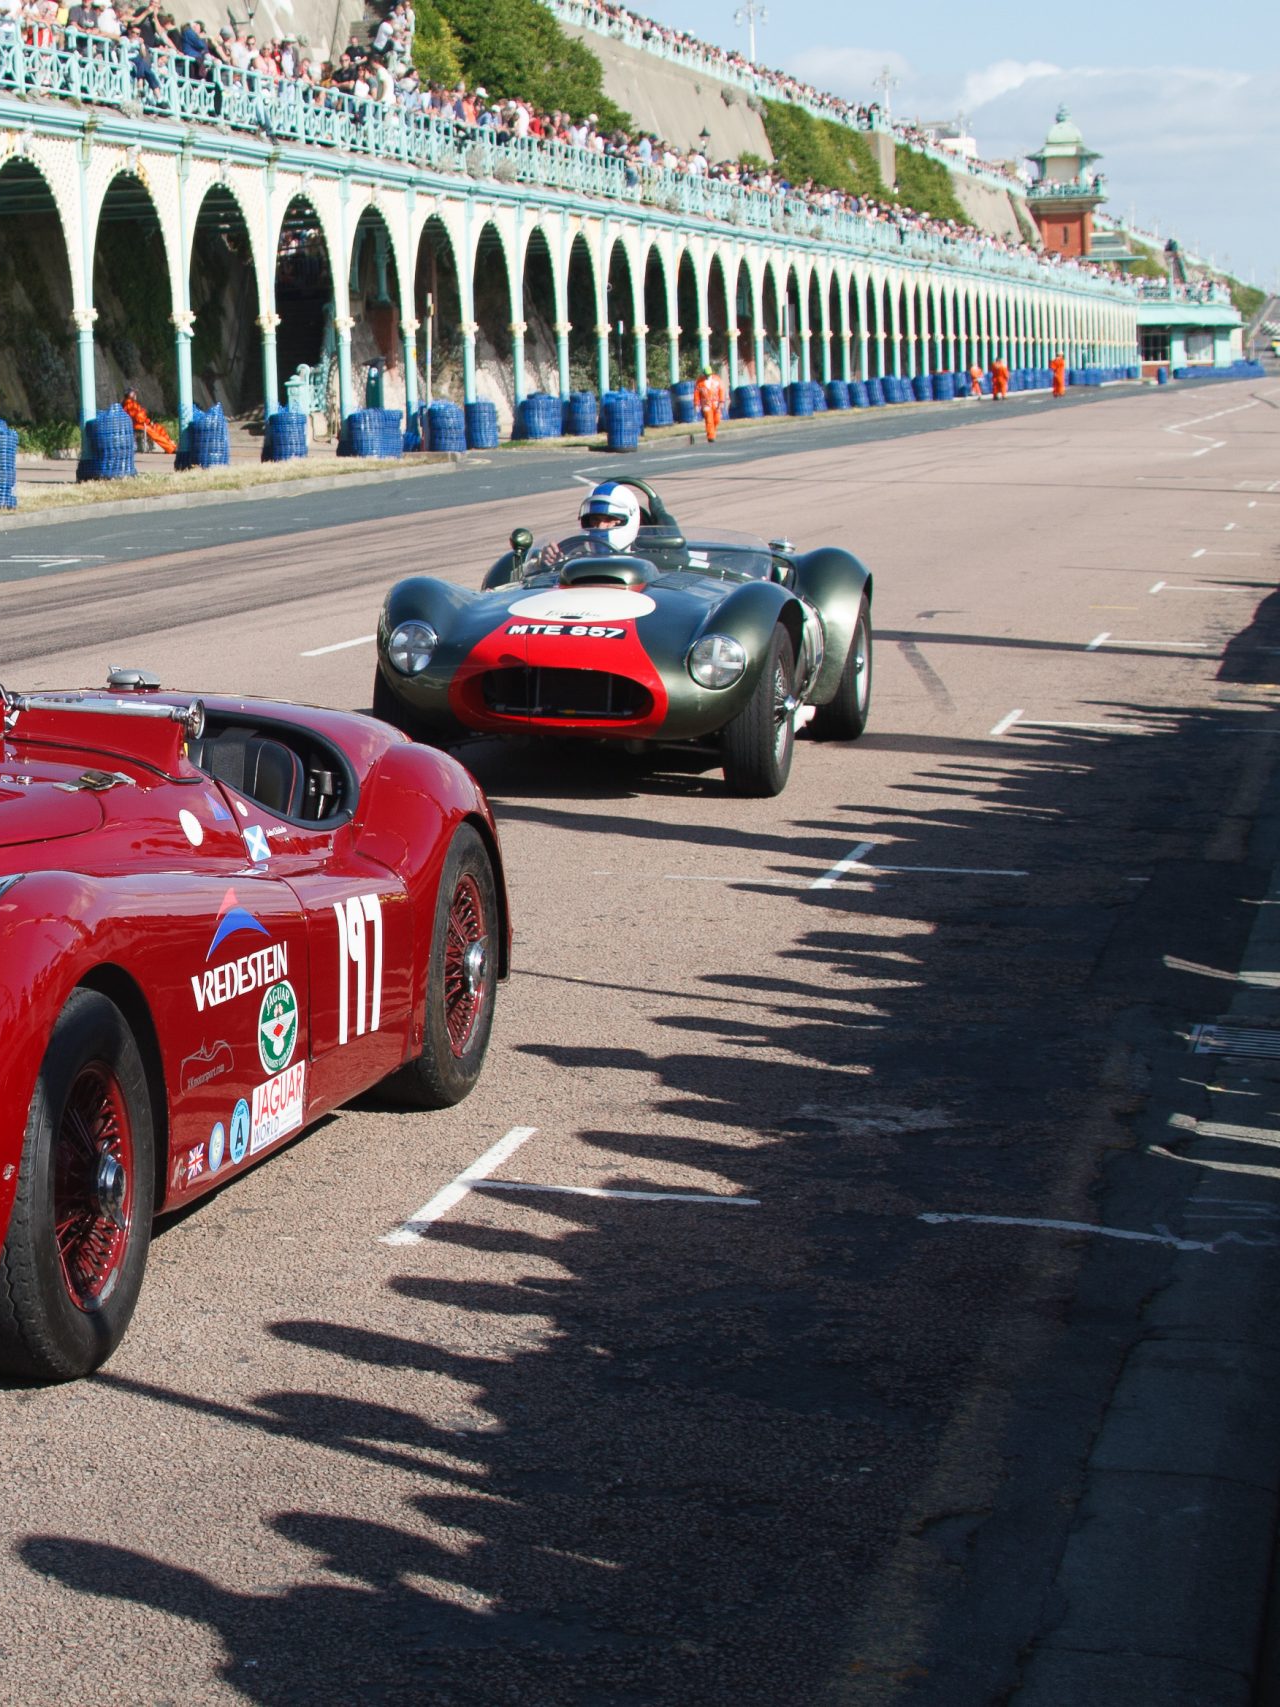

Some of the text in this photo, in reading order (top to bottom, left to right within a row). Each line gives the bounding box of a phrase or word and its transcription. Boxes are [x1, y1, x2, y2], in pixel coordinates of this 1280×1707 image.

[508, 625, 624, 638] MTE 857
[191, 940, 288, 1012] VREDESTEIN
[333, 893, 382, 1045] 197
[266, 986, 290, 1016] JAGUAR
[254, 1065, 303, 1127] JAGUAR
[235, 1118, 244, 1149] A
[253, 1115, 280, 1144] WORLD
